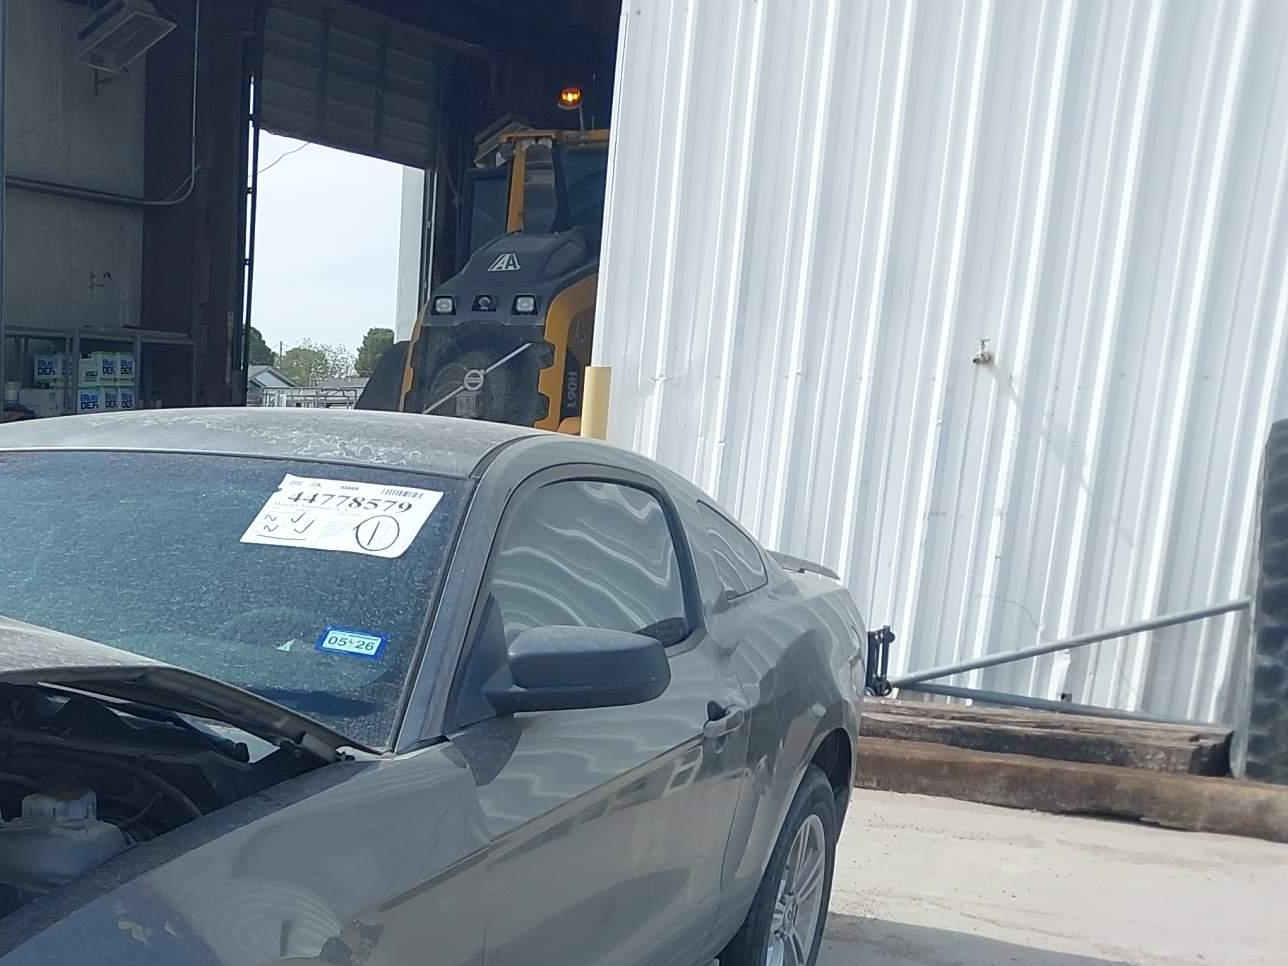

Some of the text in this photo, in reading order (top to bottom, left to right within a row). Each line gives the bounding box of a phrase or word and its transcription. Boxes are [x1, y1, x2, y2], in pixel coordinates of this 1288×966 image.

[288, 491, 413, 514] 44778579
[328, 636, 348, 646] 05
[354, 640, 376, 651] 26
